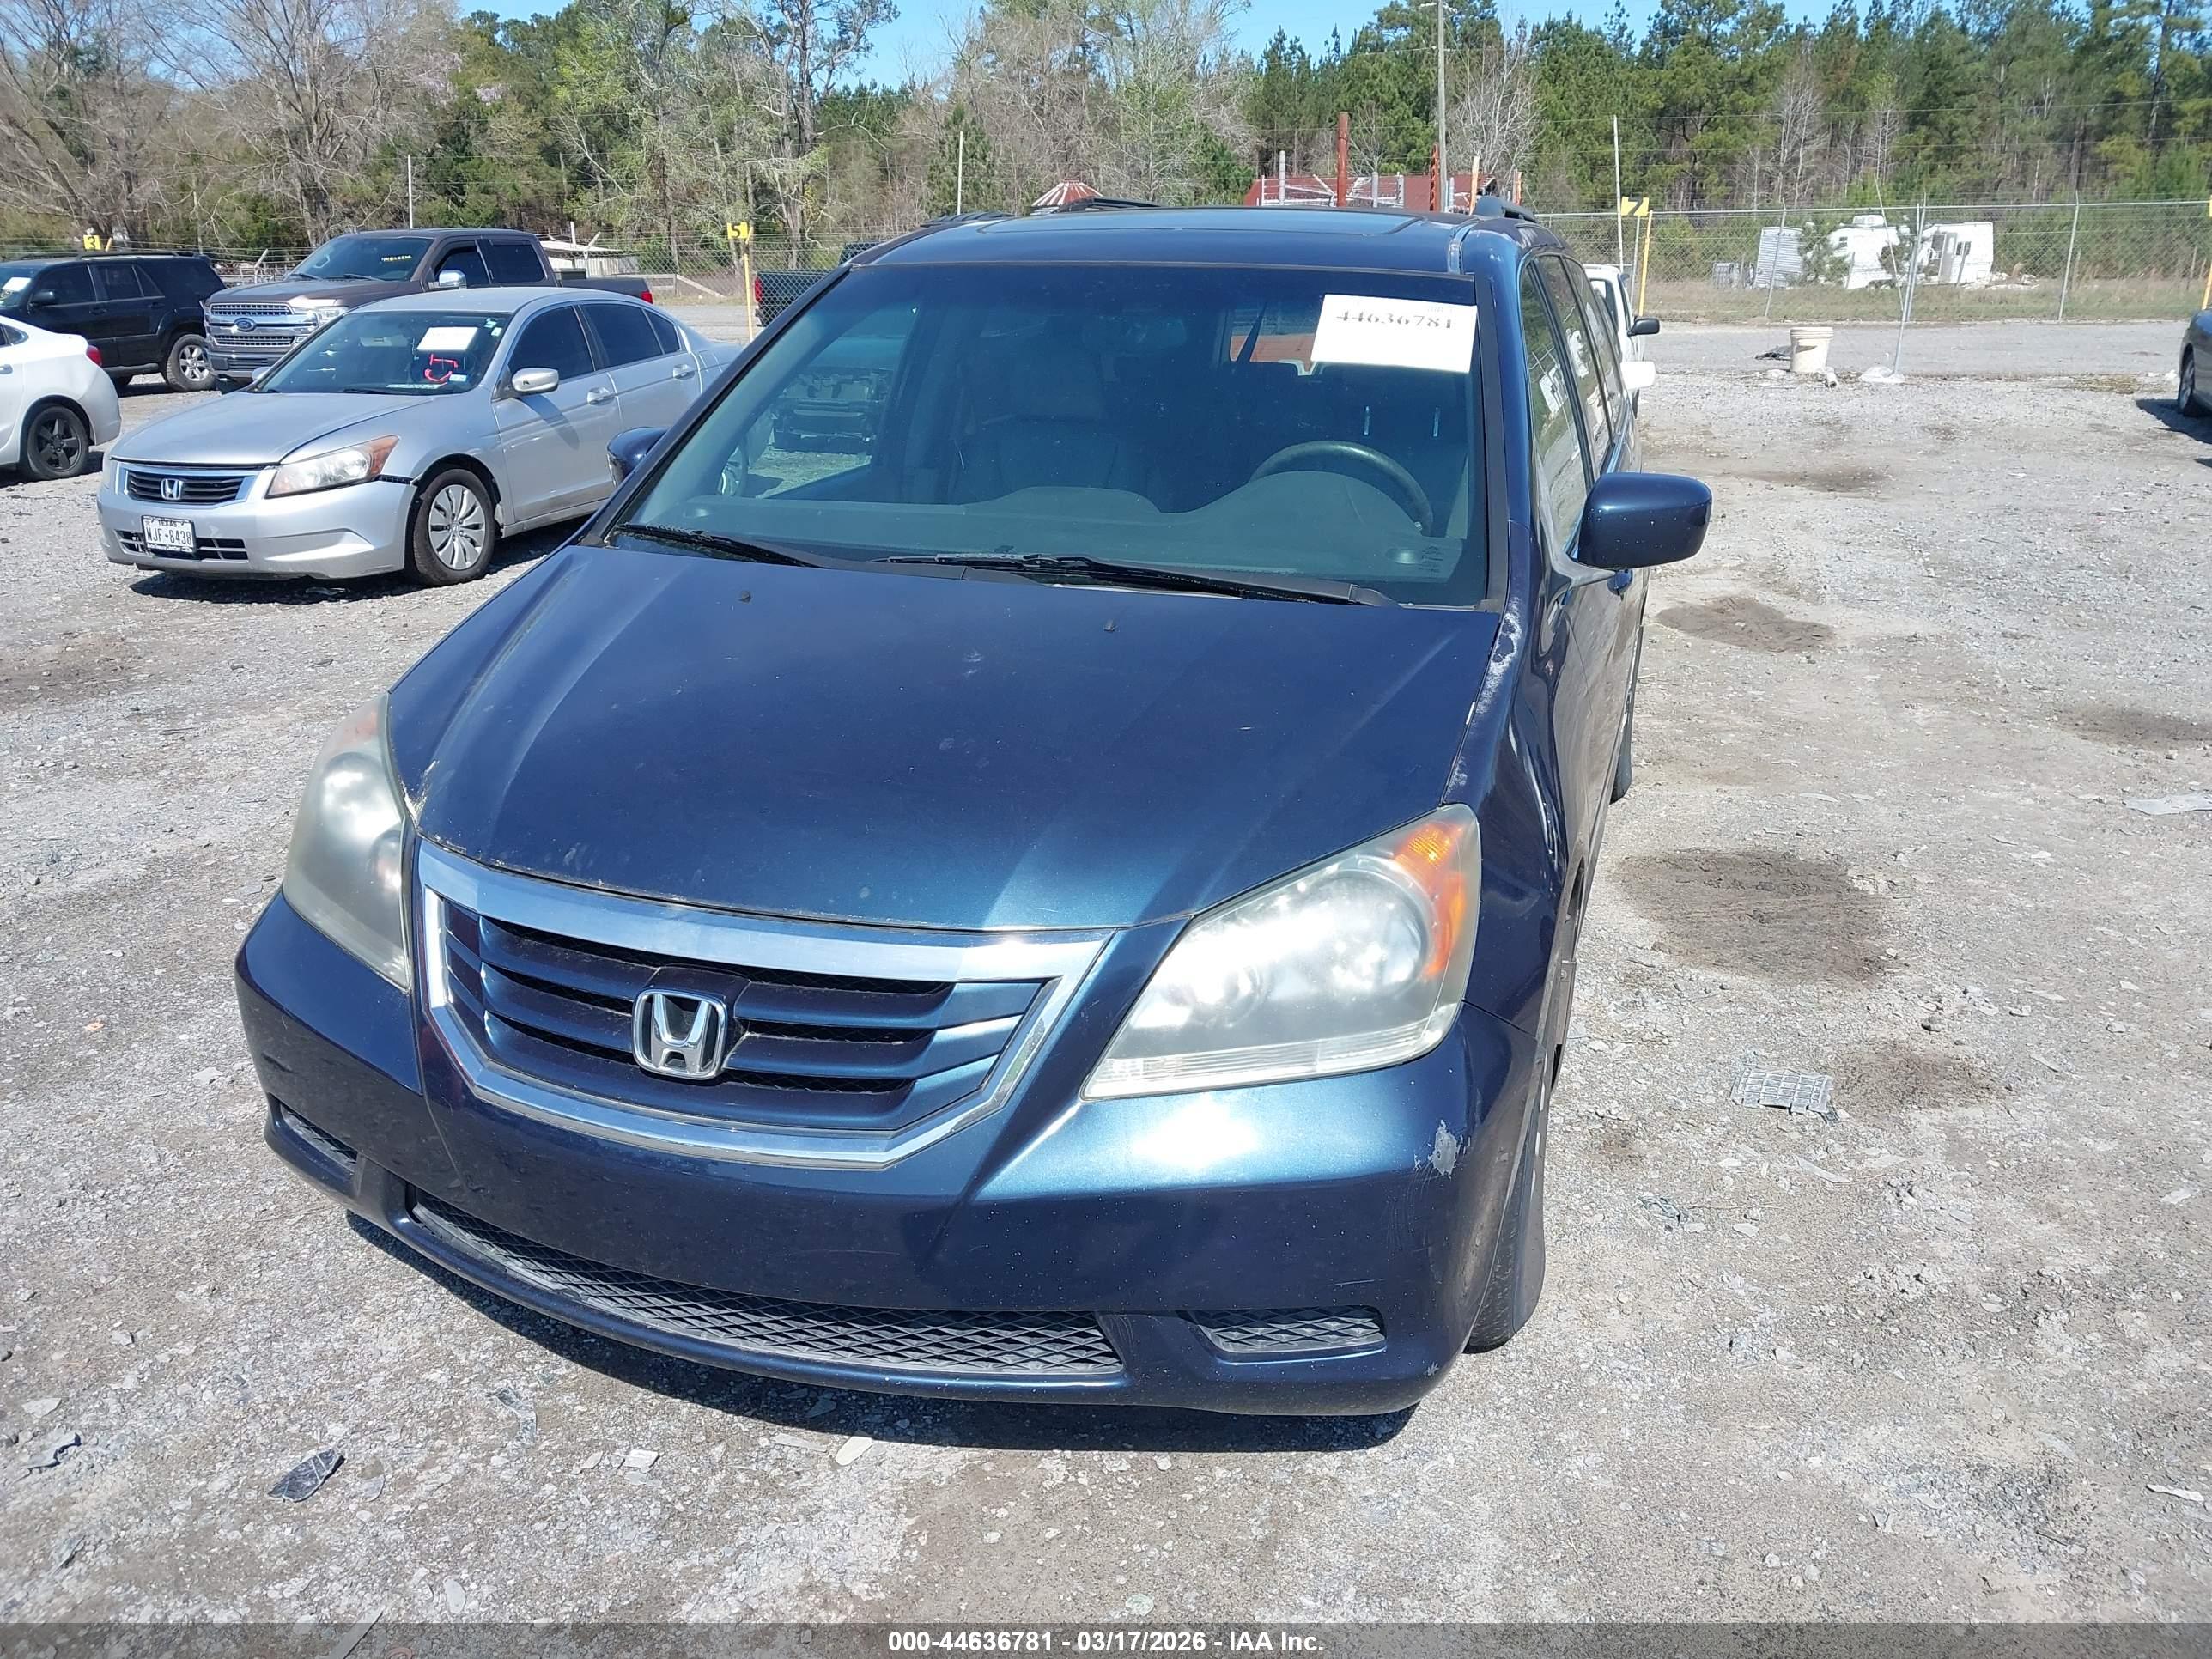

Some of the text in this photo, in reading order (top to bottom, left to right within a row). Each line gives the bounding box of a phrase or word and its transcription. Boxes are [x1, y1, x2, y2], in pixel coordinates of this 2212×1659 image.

[1628, 191, 1644, 216] 7
[731, 223, 741, 238] 5
[87, 236, 95, 249] 3
